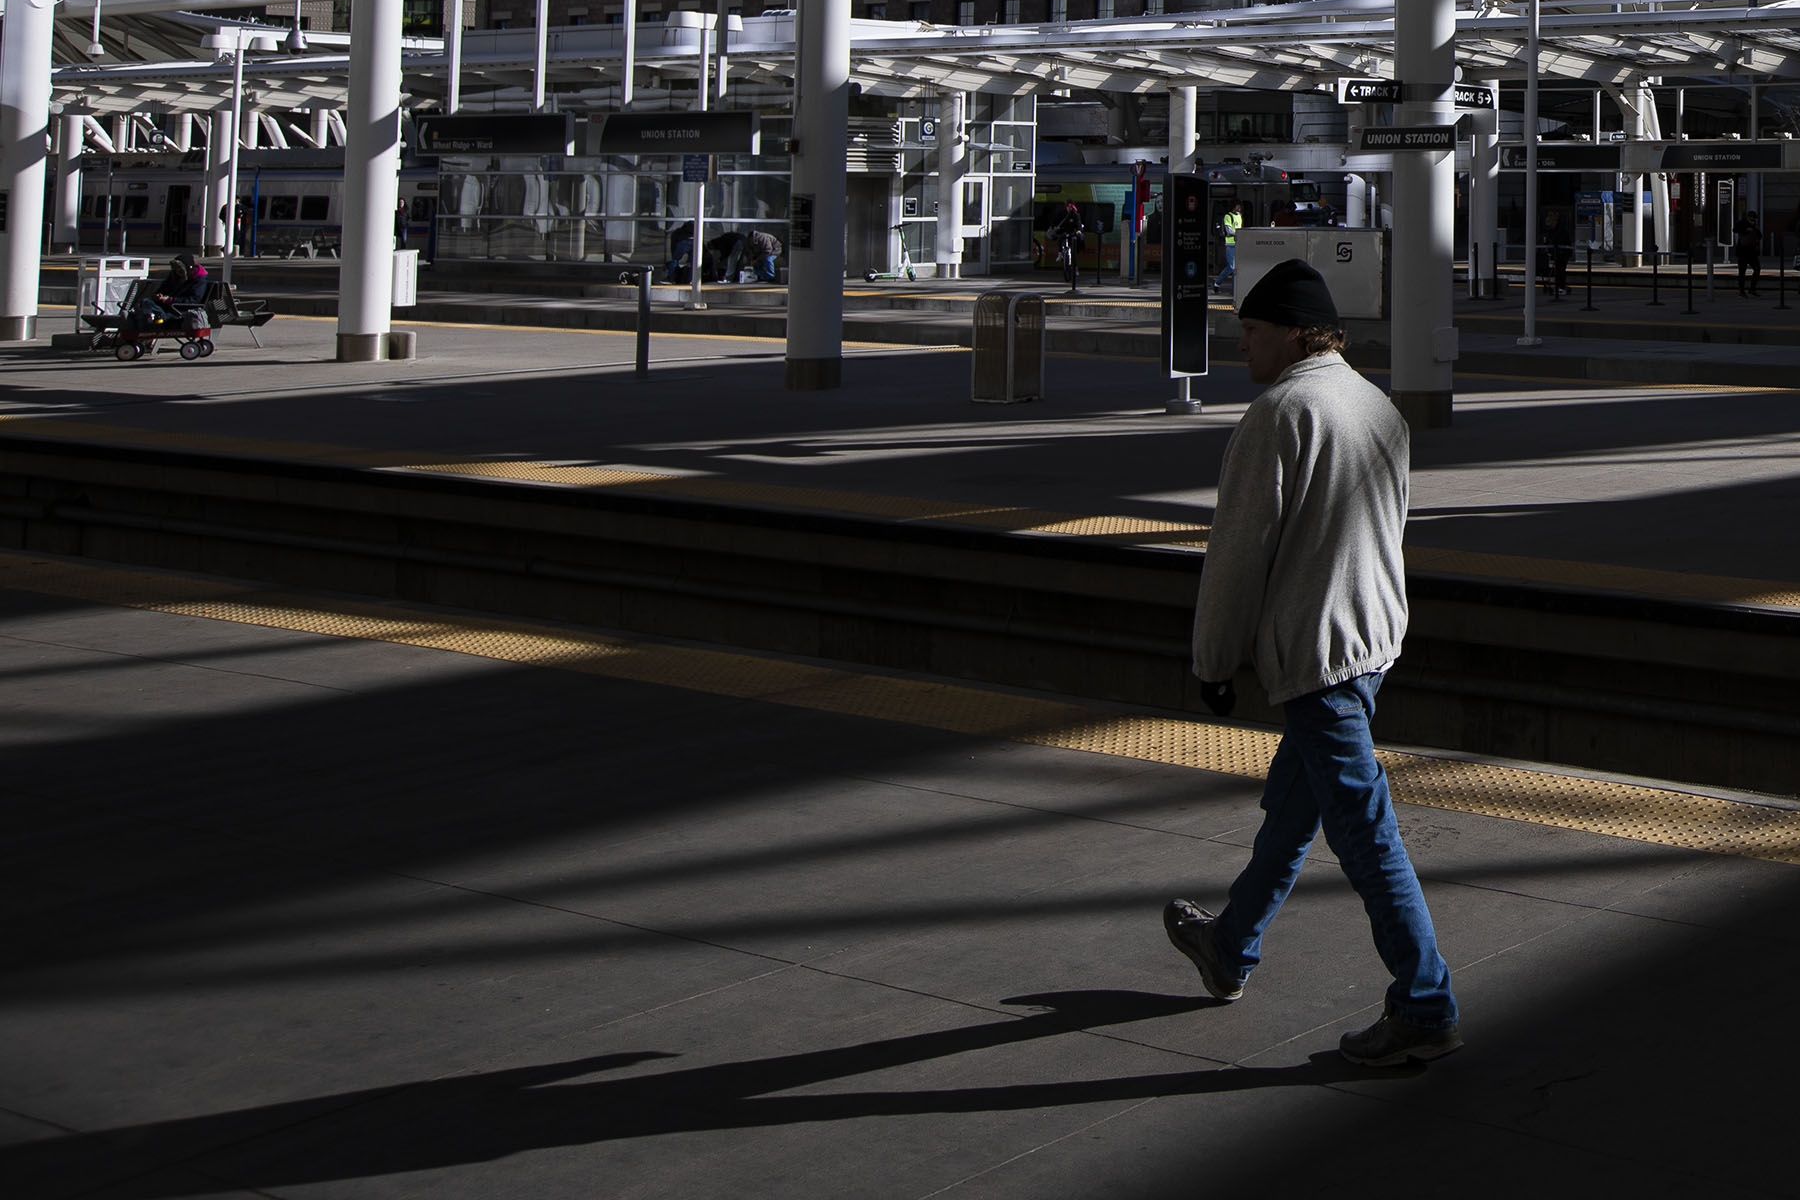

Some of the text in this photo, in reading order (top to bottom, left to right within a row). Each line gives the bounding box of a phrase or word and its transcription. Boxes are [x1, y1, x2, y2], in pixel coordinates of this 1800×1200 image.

[1360, 85, 1400, 99] TRACK 7
[1455, 90, 1484, 105] RACK 5
[641, 129, 700, 139] UNION STATION
[1367, 132, 1448, 145] UNION STATION
[433, 140, 493, 151] Wheat Ridge Ward
[1714, 153, 1741, 161] STATION
